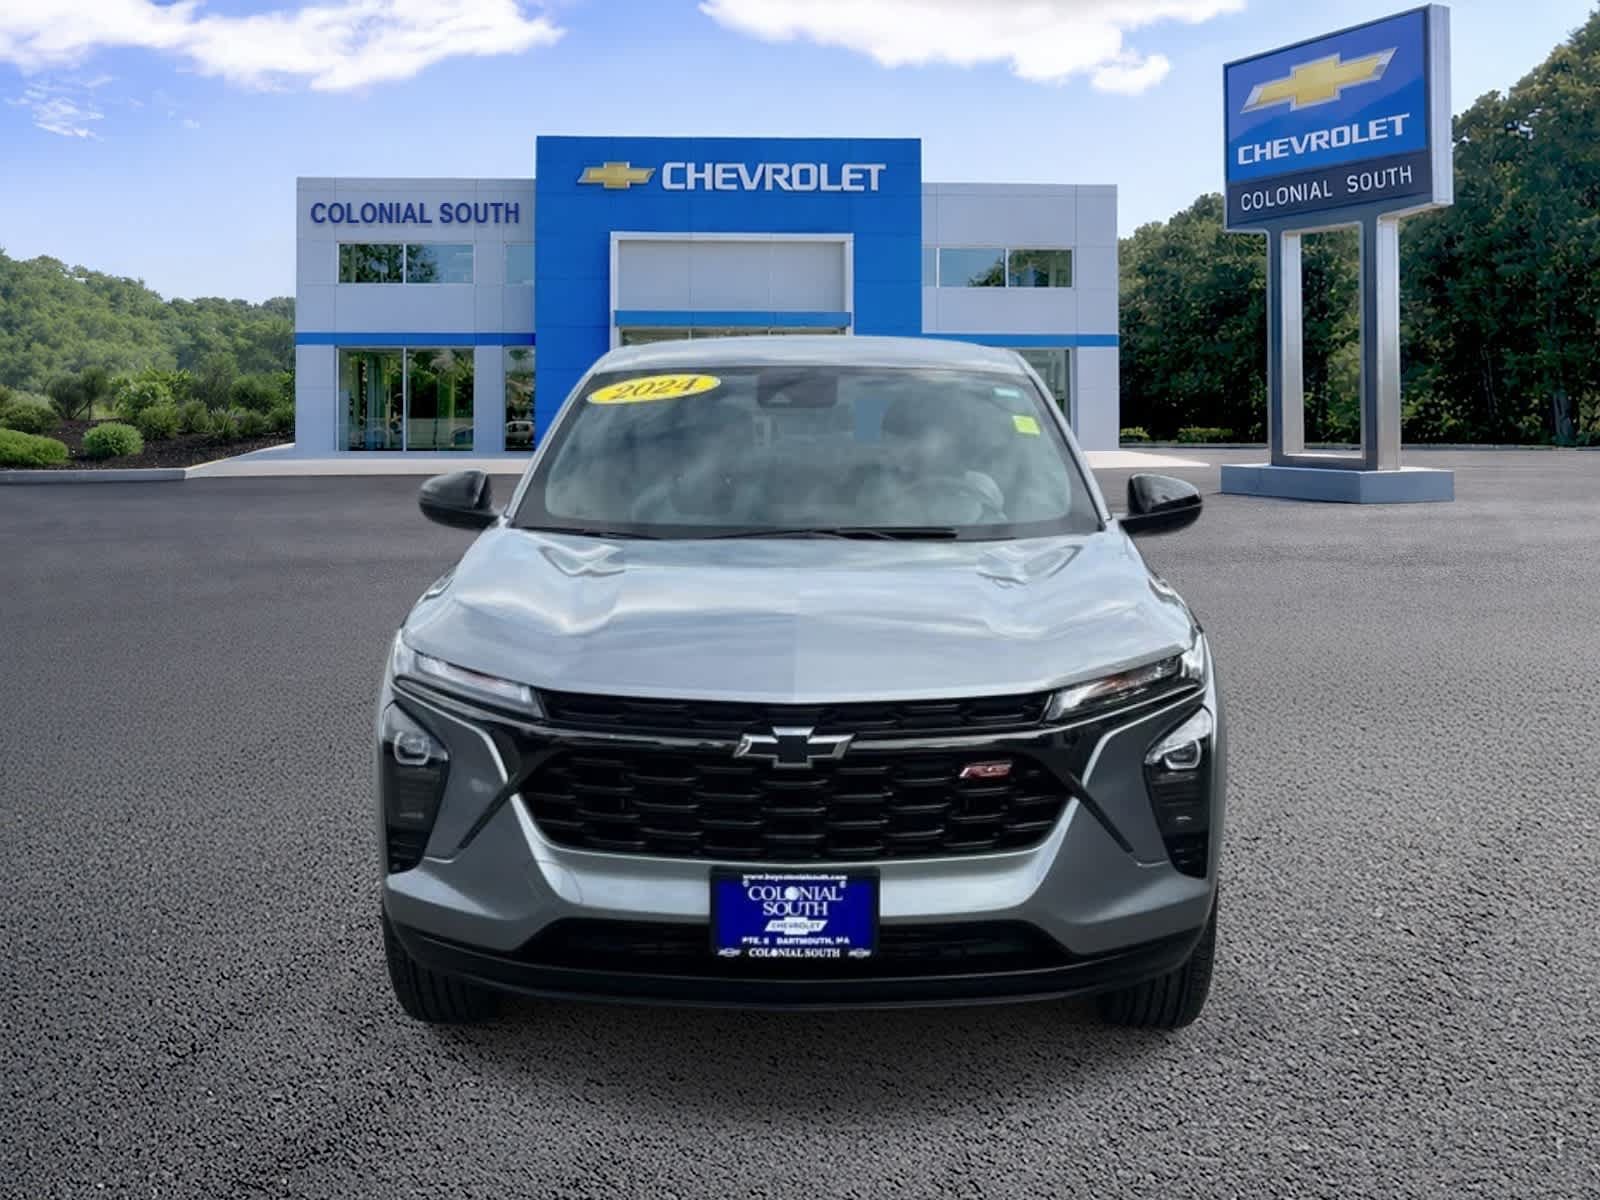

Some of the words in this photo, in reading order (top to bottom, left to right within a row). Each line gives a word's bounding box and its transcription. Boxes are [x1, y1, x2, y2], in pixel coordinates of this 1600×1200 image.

[1237, 112, 1410, 165] CHEVROLET
[661, 162, 887, 192] CHEVROLET
[1240, 179, 1333, 212] COLONIAL
[1346, 164, 1413, 194] SOUTH
[310, 202, 433, 224] COLONIAL
[439, 202, 520, 224] SOUTH
[608, 376, 700, 401] 2024
[748, 885, 844, 901] COLONIAL
[762, 901, 829, 917] SOUTH
[771, 921, 822, 930] CHEVROLET
[748, 947, 804, 959] COLONIAL
[804, 947, 841, 959] SOUTH
